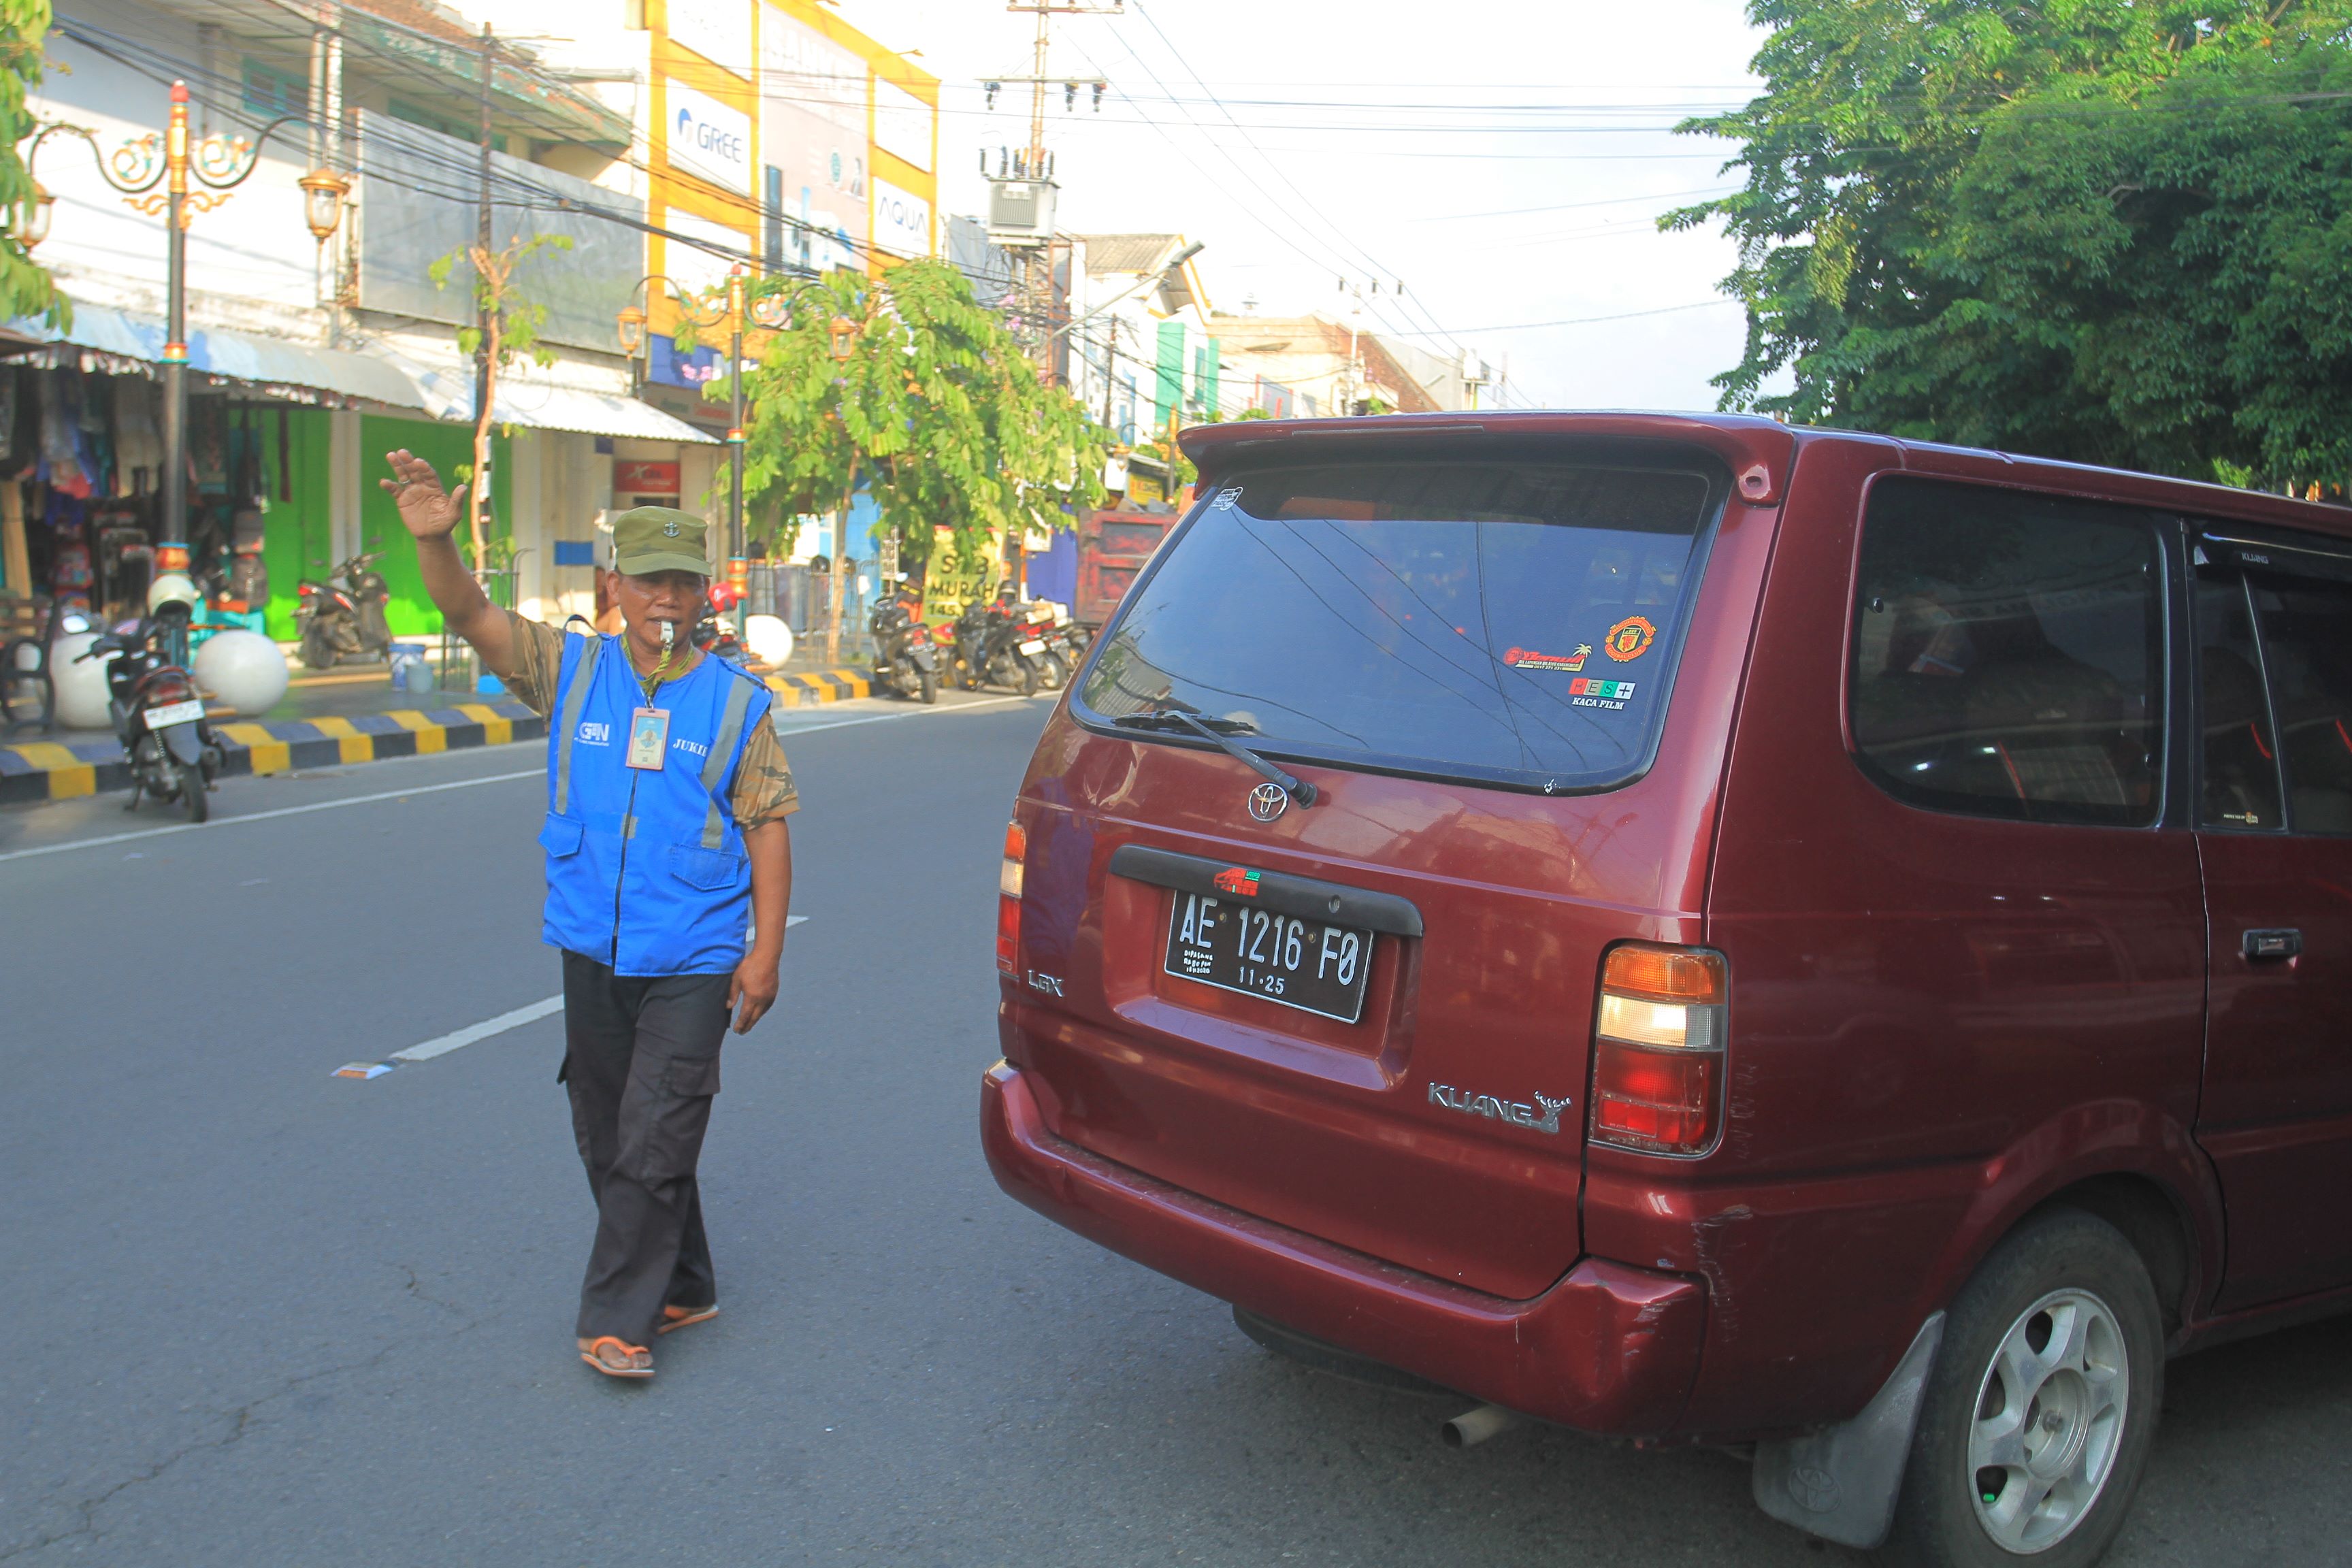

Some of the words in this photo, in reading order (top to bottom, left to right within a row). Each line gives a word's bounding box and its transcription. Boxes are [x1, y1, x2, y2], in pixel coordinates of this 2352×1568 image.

[698, 122, 742, 164] GREE
[879, 196, 930, 238] AQUA
[928, 581, 999, 599] MURAH
[1572, 697, 1597, 708] KACA
[1598, 700, 1625, 710] FILM
[1179, 894, 1218, 949] AE
[1238, 907, 1304, 971] 1216
[1184, 949, 1213, 961] DIPASANG
[1028, 970, 1065, 998] LGX
